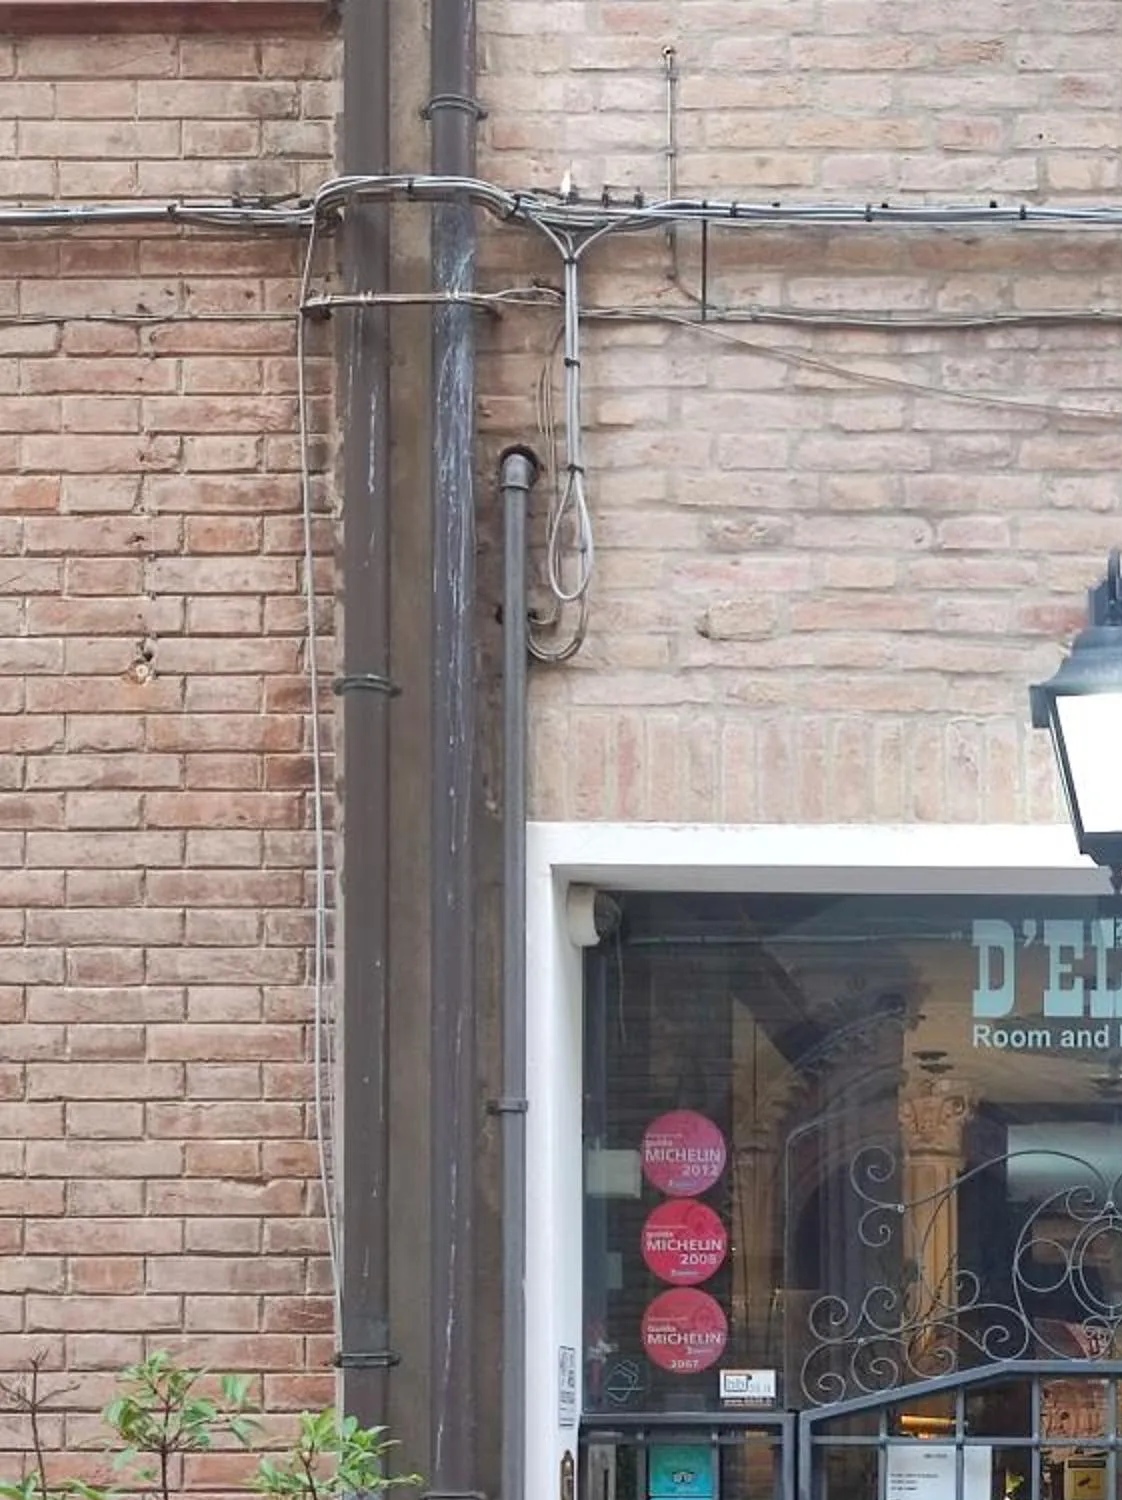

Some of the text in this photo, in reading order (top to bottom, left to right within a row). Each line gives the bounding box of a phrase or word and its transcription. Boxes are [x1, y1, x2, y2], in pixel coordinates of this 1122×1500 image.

[972, 1025, 1051, 1049] Room
[1060, 1025, 1110, 1049] and
[645, 1147, 721, 1162] MICHELIN
[646, 1239, 722, 1252] MICHELIN
[646, 1332, 722, 1345] MICHELIN
